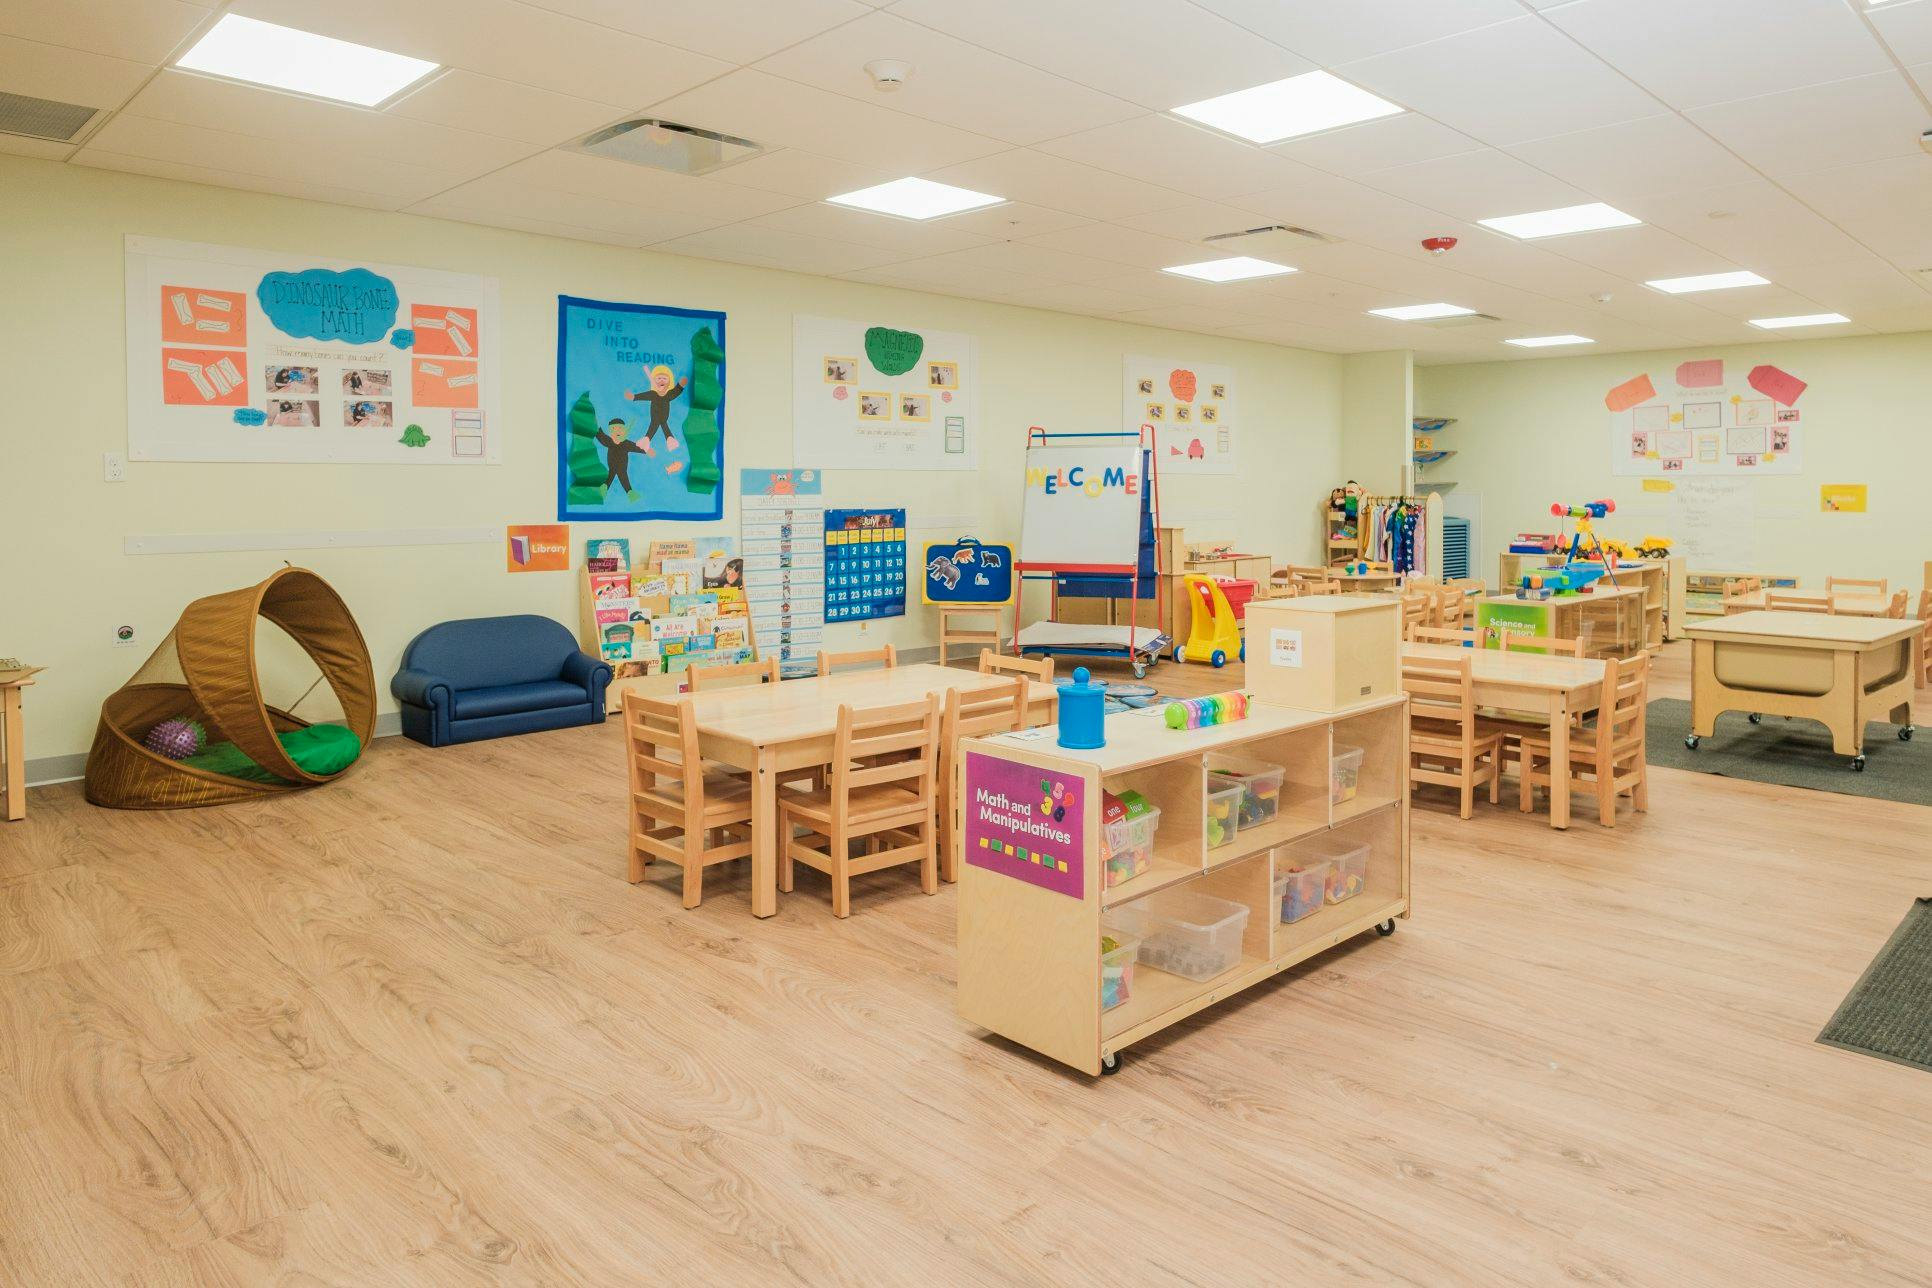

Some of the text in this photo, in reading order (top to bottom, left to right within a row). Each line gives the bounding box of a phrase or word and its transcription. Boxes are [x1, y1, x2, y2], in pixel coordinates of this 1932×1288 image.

[272, 280, 390, 311] DINOSAUR BONE
[321, 310, 365, 336] MATH
[586, 318, 623, 332] DIVE
[604, 335, 640, 350] INTO
[616, 351, 675, 365] READING
[1026, 466, 1138, 497] WELCOME
[862, 516, 877, 527] July
[532, 543, 567, 555] Library
[852, 547, 857, 555] 2
[864, 546, 868, 554] 3
[875, 545, 880, 553] 4
[897, 544, 902, 552] 6
[830, 558, 903, 571] 7 8 9 10 11 12 13
[828, 577, 835, 585] 14
[839, 577, 847, 585] 15
[851, 576, 858, 584] 16
[863, 574, 870, 582] 17
[875, 574, 882, 582] 18
[886, 573, 893, 581] 19
[895, 572, 904, 580] 20
[828, 593, 836, 602] 21
[838, 592, 847, 600] 22
[850, 591, 860, 599] 23
[862, 590, 872, 598] 24
[873, 588, 883, 597] 25
[884, 588, 893, 596] 26
[895, 586, 904, 595] 27
[828, 604, 870, 617] 28 29 30 31
[1490, 617, 1523, 628] Science
[976, 787, 1031, 816] Math and
[1107, 803, 1144, 817] one four
[980, 805, 1071, 844] Manipulatives
